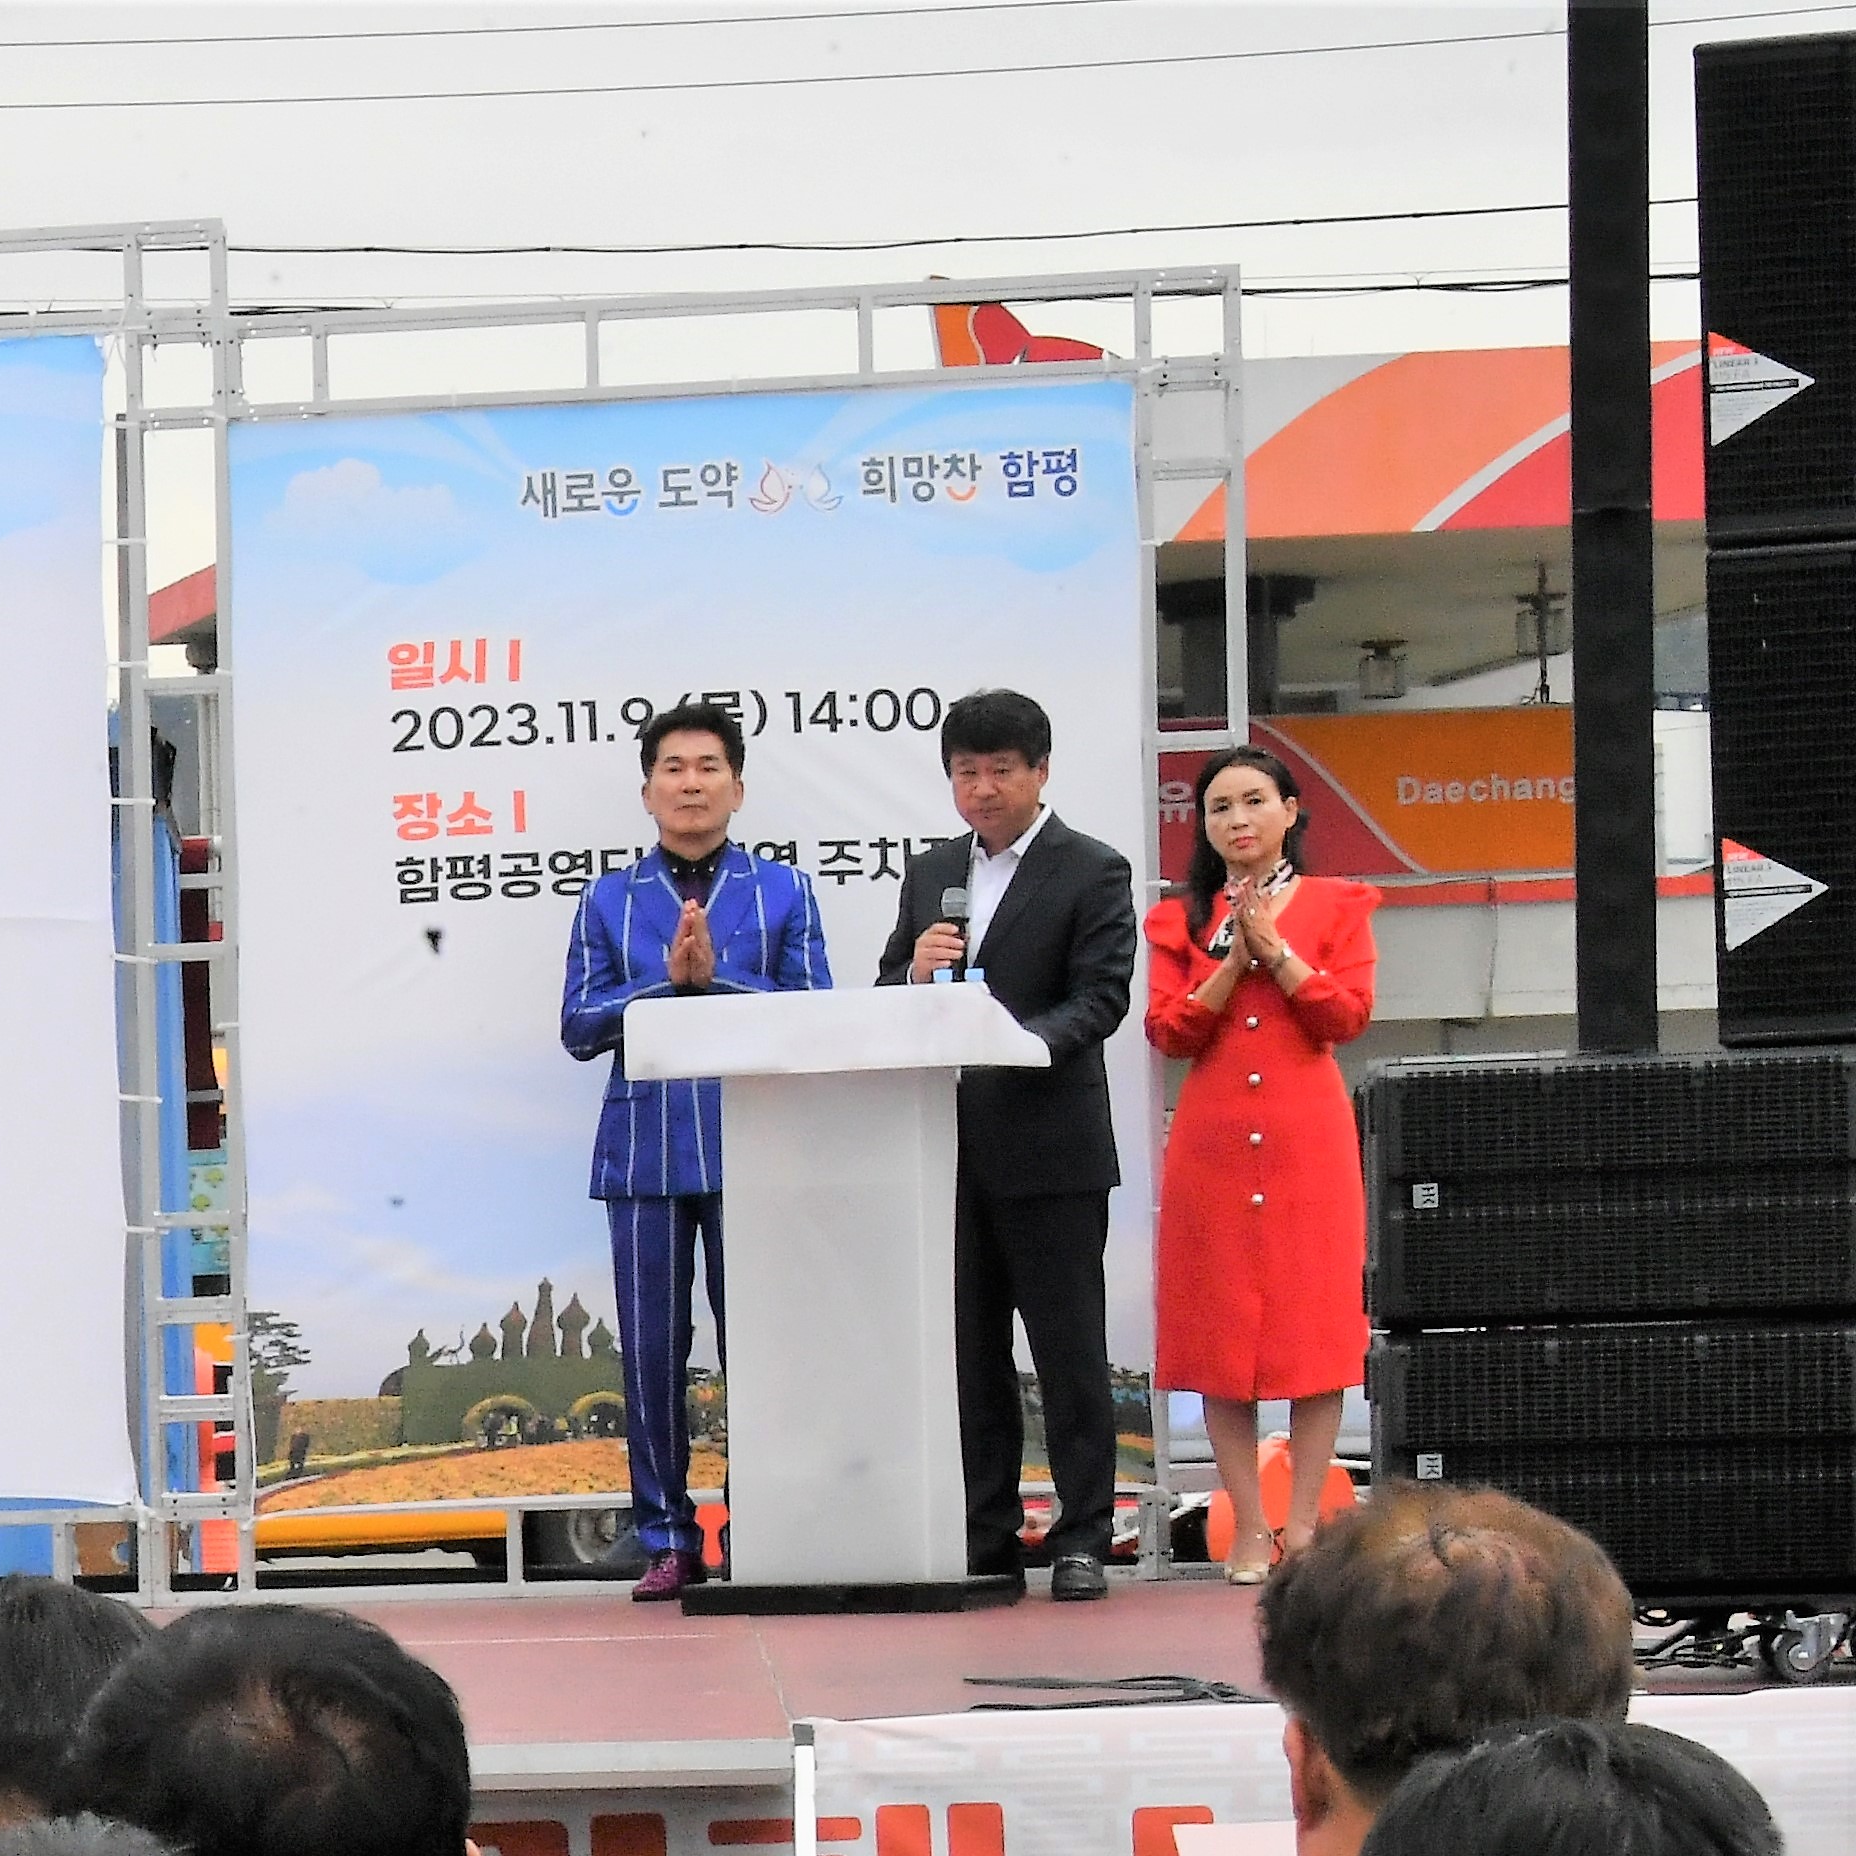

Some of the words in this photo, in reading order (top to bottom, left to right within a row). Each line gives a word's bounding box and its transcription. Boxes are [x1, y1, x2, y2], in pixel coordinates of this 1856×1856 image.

[520, 467, 641, 518] 새로운
[658, 461, 739, 509] 도약
[861, 453, 982, 503] 희망찬
[999, 447, 1080, 499] 함평
[387, 638, 488, 690] 일시
[392, 790, 494, 841] 장소
[1397, 773, 1575, 807] Daechang
[818, 836, 953, 886] 주차
